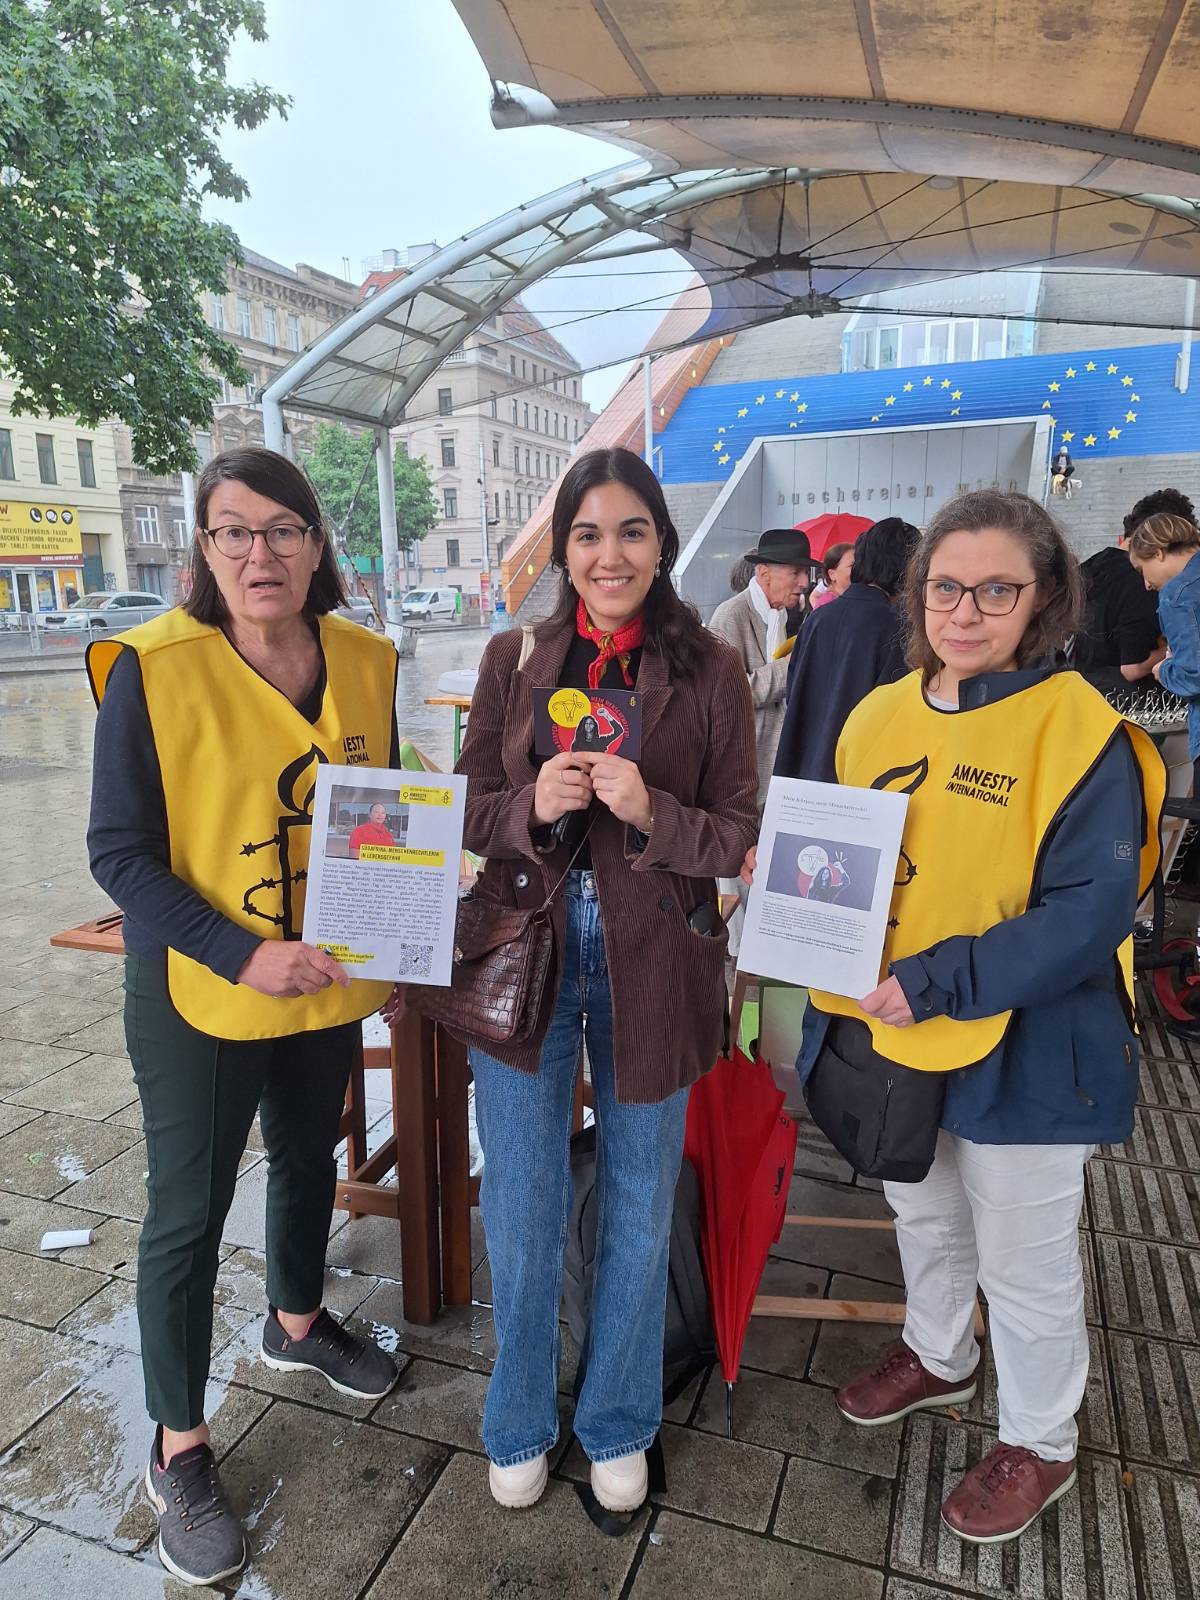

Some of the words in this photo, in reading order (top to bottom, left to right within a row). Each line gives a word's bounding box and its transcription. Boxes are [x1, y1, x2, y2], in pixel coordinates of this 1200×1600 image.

[776, 484, 934, 505] buechereien
[951, 763, 1018, 793] AMNESTY
[944, 781, 1009, 807] INTERNATIONAL
